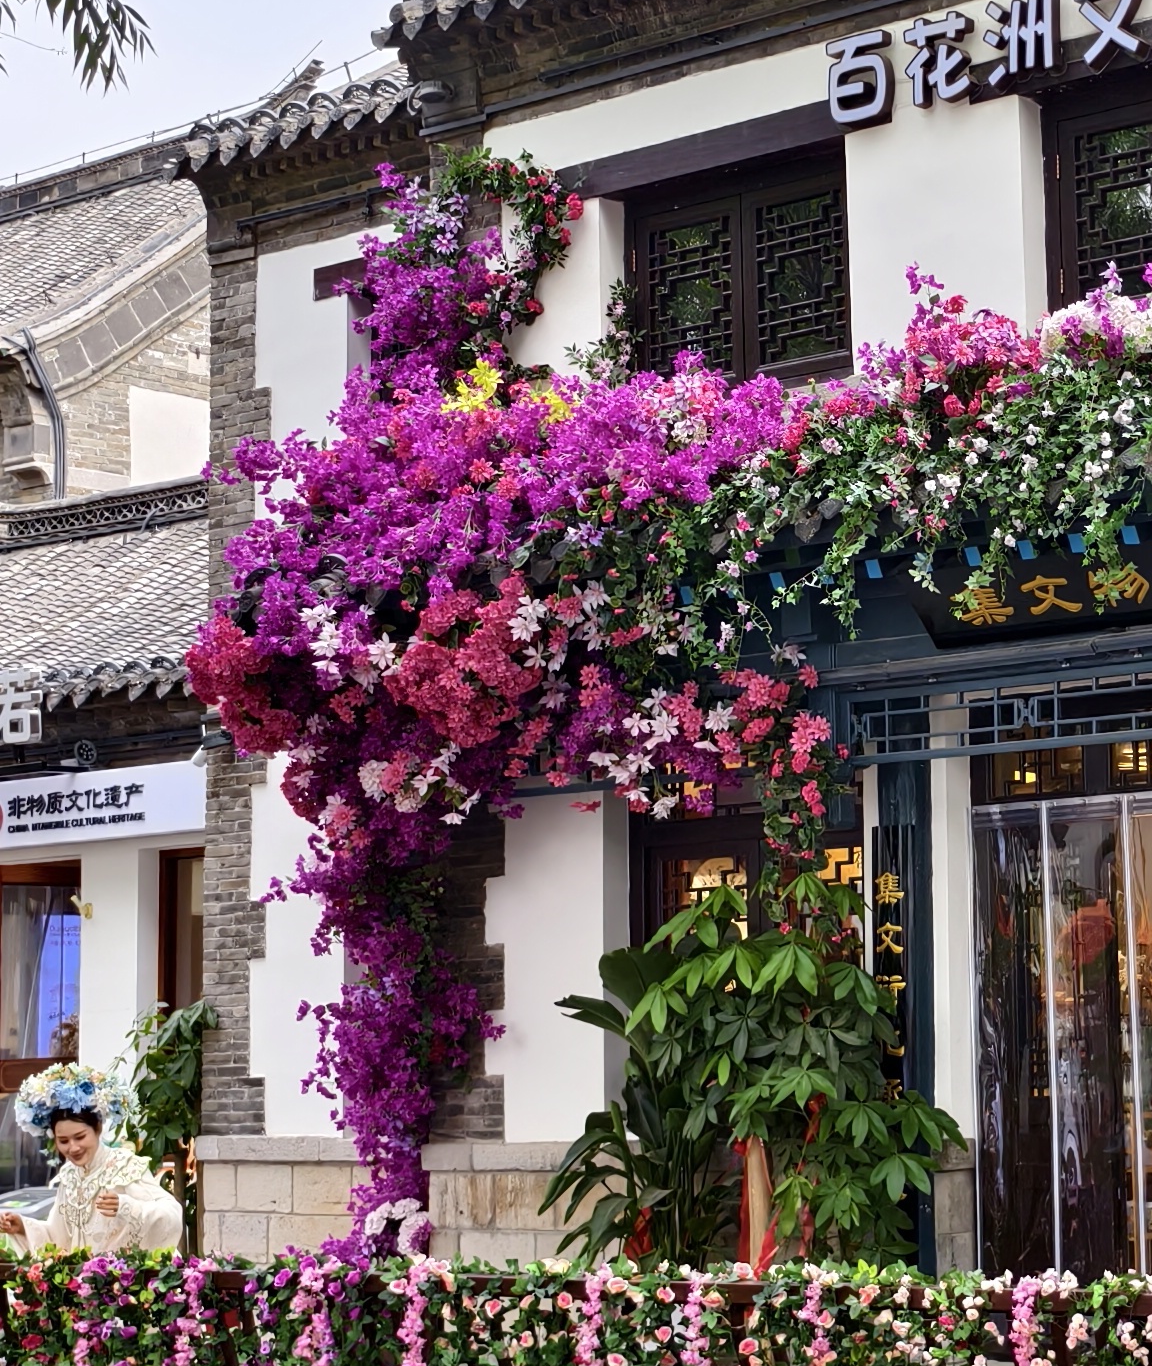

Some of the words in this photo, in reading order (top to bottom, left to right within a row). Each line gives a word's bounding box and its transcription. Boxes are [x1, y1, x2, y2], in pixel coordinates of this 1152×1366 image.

[7, 783, 145, 819] 非物质文化遗产
[7, 824, 30, 833] CHINA
[71, 815, 107, 827] CULTURAL
[108, 811, 145, 824] HERITAGE
